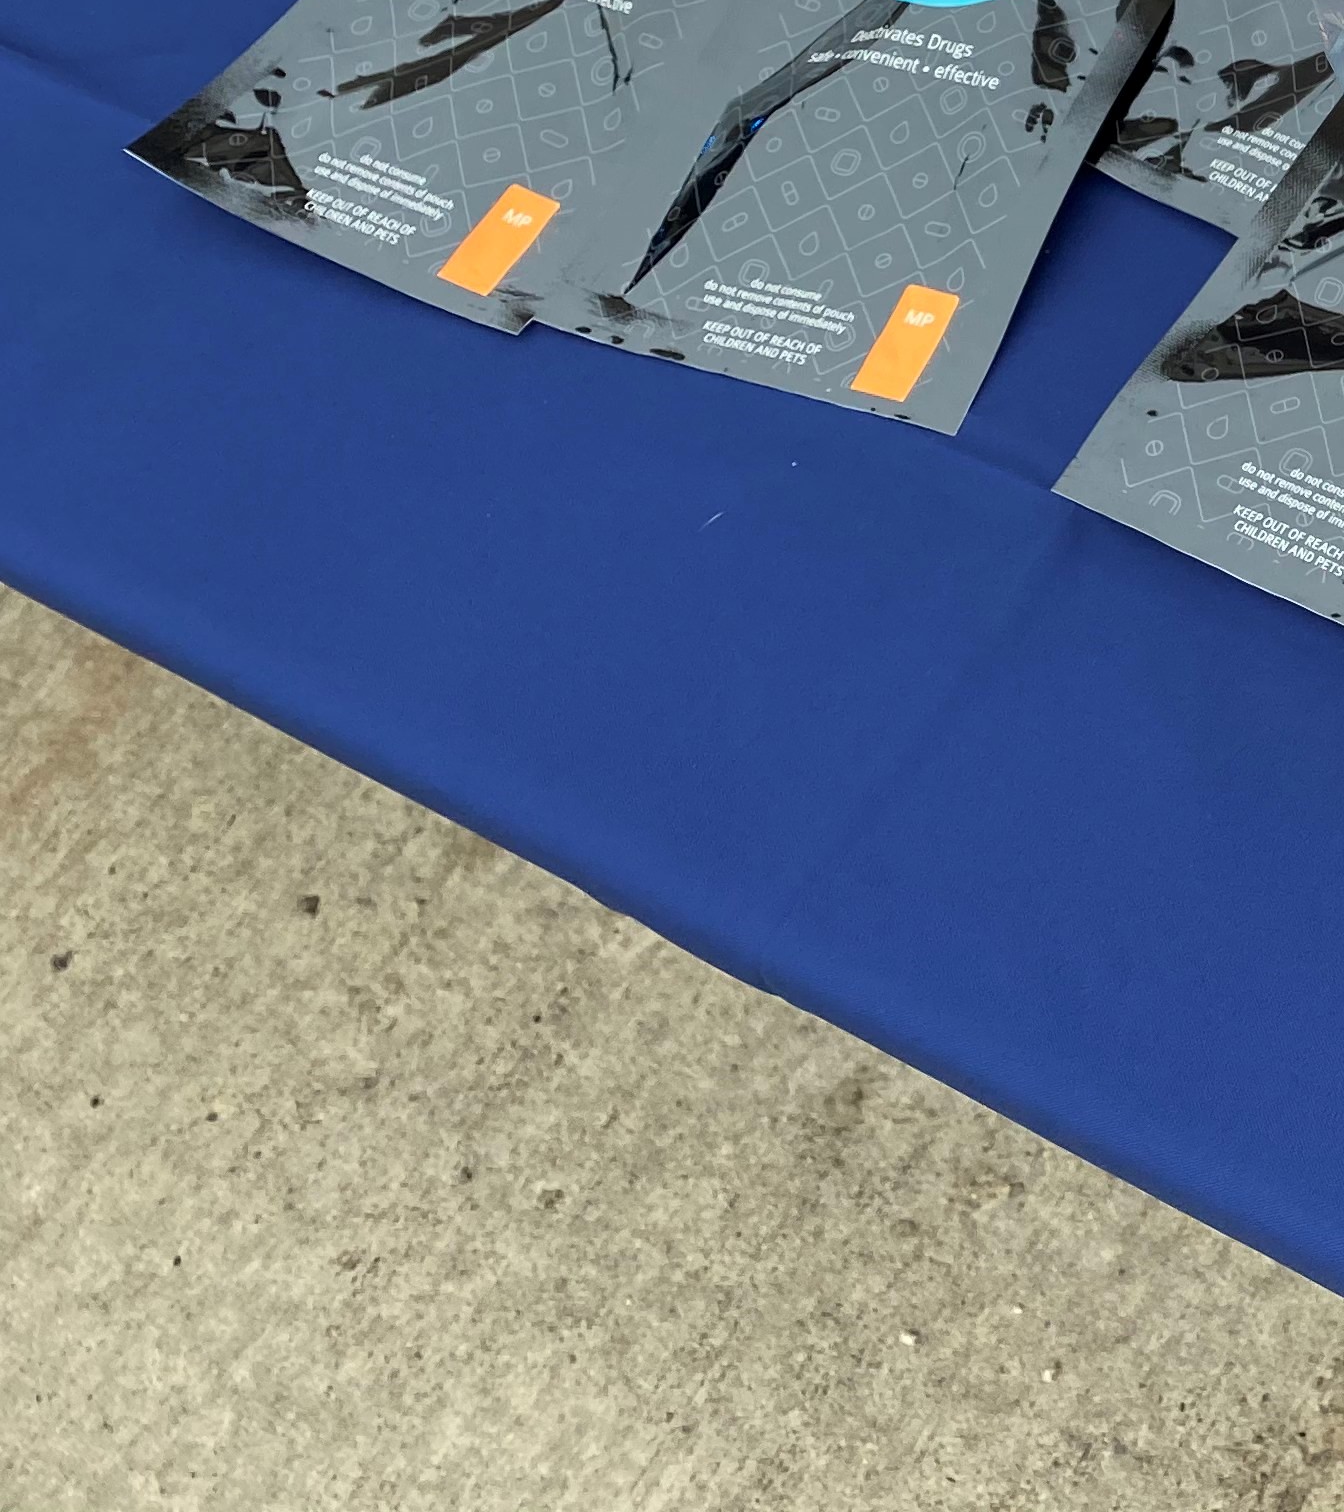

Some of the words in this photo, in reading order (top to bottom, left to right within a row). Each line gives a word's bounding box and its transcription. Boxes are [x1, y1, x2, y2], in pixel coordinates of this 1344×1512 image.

[927, 33, 973, 59] Drugs
[934, 63, 999, 89] effective
[1209, 158, 1235, 172] KEEP
[1233, 167, 1258, 183] OUT
[1254, 176, 1272, 189] OF
[1241, 461, 1256, 474] do
[1255, 469, 1275, 483] not
[1274, 477, 1312, 498] remove
[1289, 468, 1304, 480] do
[1303, 474, 1323, 488] not
[1238, 476, 1257, 490] use
[1257, 484, 1279, 499] and
[1277, 493, 1316, 515] dispose
[1315, 509, 1330, 520] of
[1232, 503, 1263, 522] KEEP
[1262, 516, 1289, 534] OUT
[1287, 527, 1306, 541] OF
[1304, 534, 1344, 560] REACH
[1233, 519, 1289, 551] CHILDREN
[1288, 544, 1315, 562] AND
[1314, 555, 1344, 576] PETS
